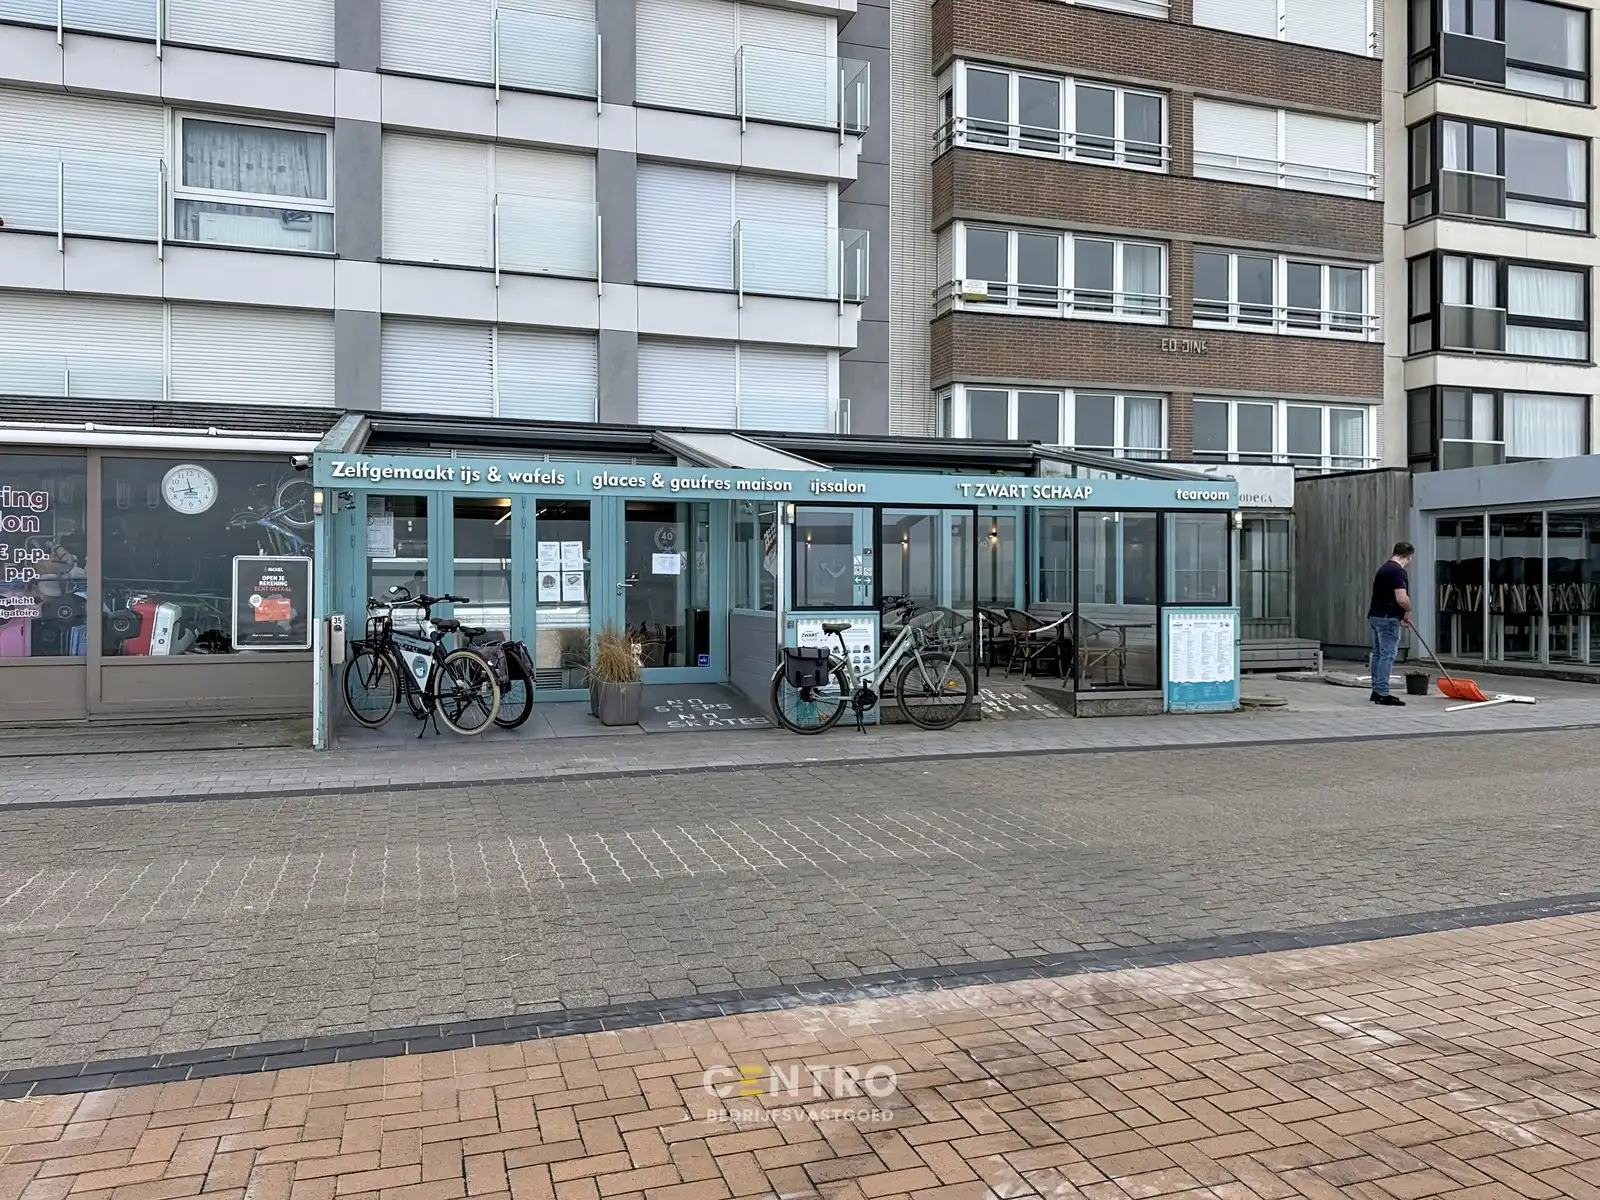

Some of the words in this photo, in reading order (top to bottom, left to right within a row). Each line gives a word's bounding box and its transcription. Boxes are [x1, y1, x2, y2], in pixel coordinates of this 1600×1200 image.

[331, 461, 455, 482] Zelfgemaakt
[460, 466, 481, 485] ijs
[487, 466, 502, 482] &
[507, 468, 565, 485] wafels
[592, 471, 646, 489] glaces
[651, 472, 665, 488] &
[670, 474, 731, 492] gaufres
[736, 476, 792, 491] maison
[810, 478, 866, 494] ijssalon
[975, 483, 1029, 498] ZWART
[1032, 484, 1093, 500] SCHAAP
[1176, 489, 1230, 501] tearoom
[0, 510, 40, 533] on
[661, 532, 673, 541] 40
[14, 548, 50, 563] p.p.
[5, 567, 40, 582] p.p.
[333, 616, 342, 625] 35
[667, 717, 770, 728] SKATES
